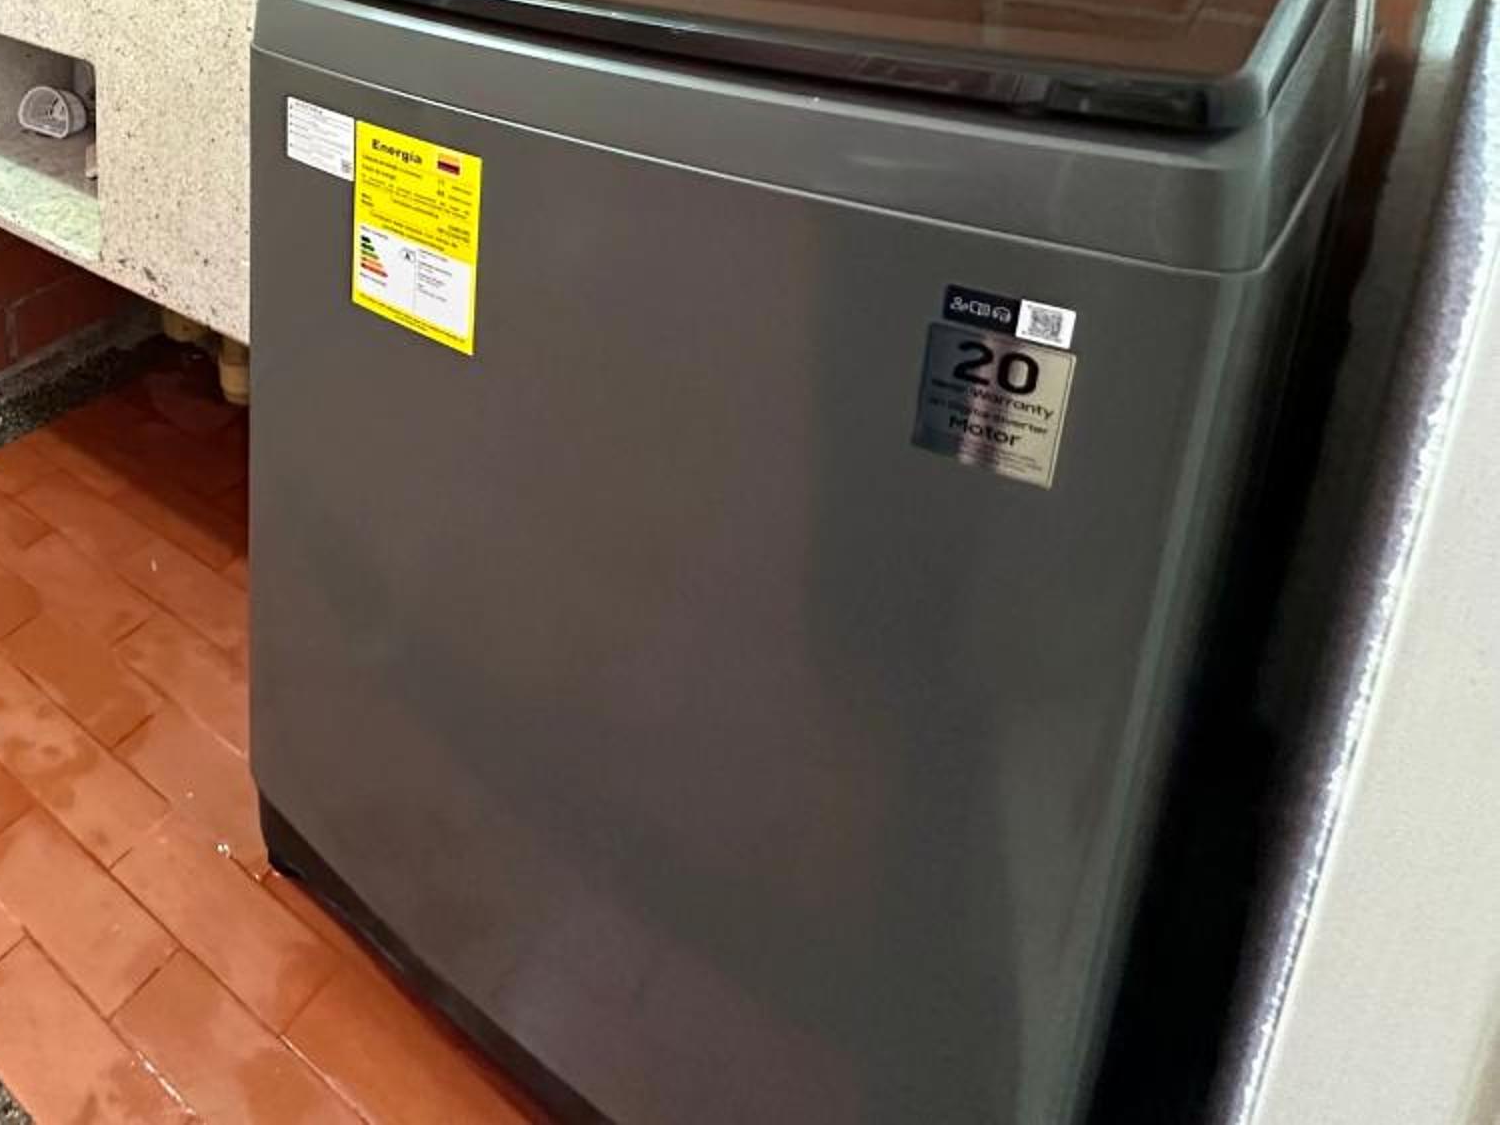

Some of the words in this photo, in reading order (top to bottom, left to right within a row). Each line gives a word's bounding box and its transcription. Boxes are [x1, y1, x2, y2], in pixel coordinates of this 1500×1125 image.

[952, 339, 1040, 396] 20
[969, 385, 1054, 420] warranty
[949, 415, 1022, 446] Motor
